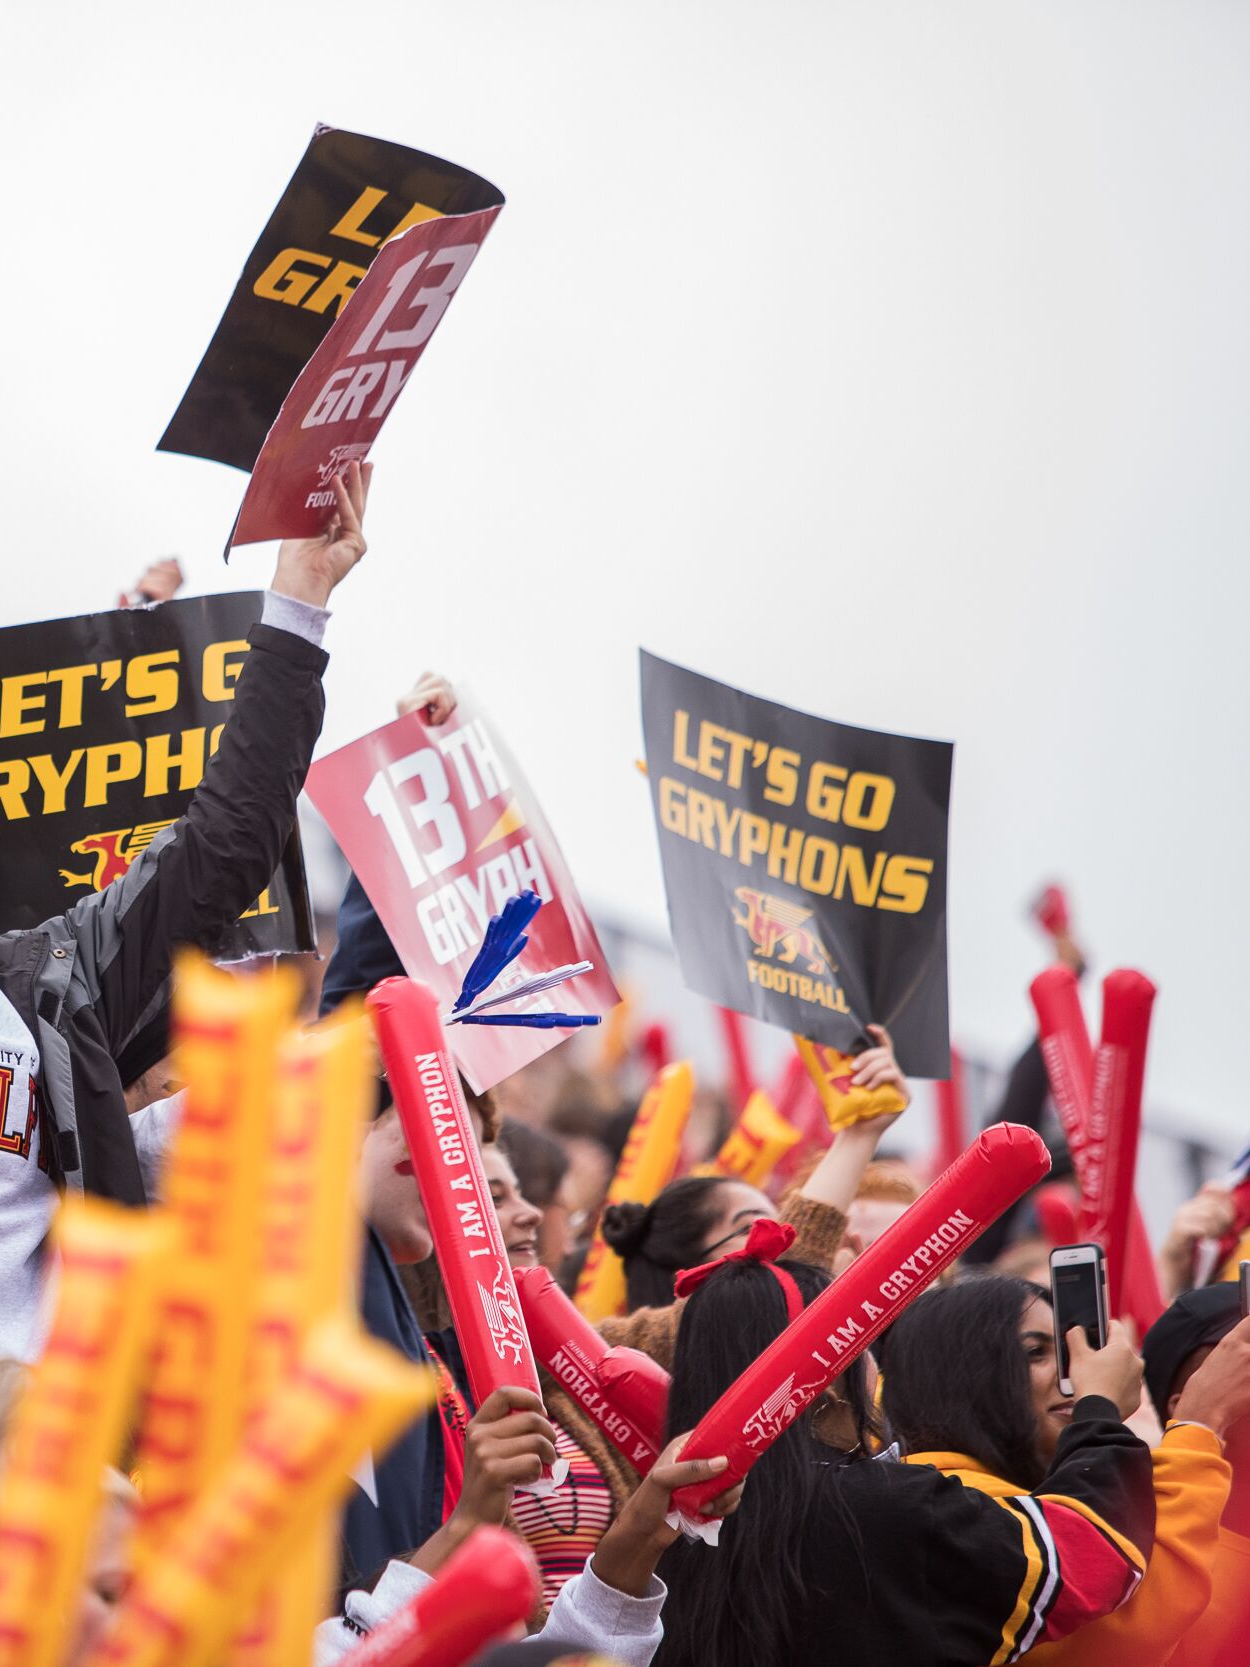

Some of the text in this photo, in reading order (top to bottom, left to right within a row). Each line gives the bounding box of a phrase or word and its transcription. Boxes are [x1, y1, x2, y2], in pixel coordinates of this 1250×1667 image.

[673, 710, 896, 832] LET'S GO
[659, 776, 934, 914] GRYPHONS
[746, 960, 850, 1015] FOOTBALL
[414, 1052, 466, 1166] GRYPHON
[450, 1173, 474, 1191] A
[456, 1200, 486, 1238] AM
[469, 1247, 490, 1258] I
[811, 1208, 974, 1368] I AM A GRYPHON
[549, 1351, 631, 1443] GRYPHON
[631, 1442, 650, 1461] A
